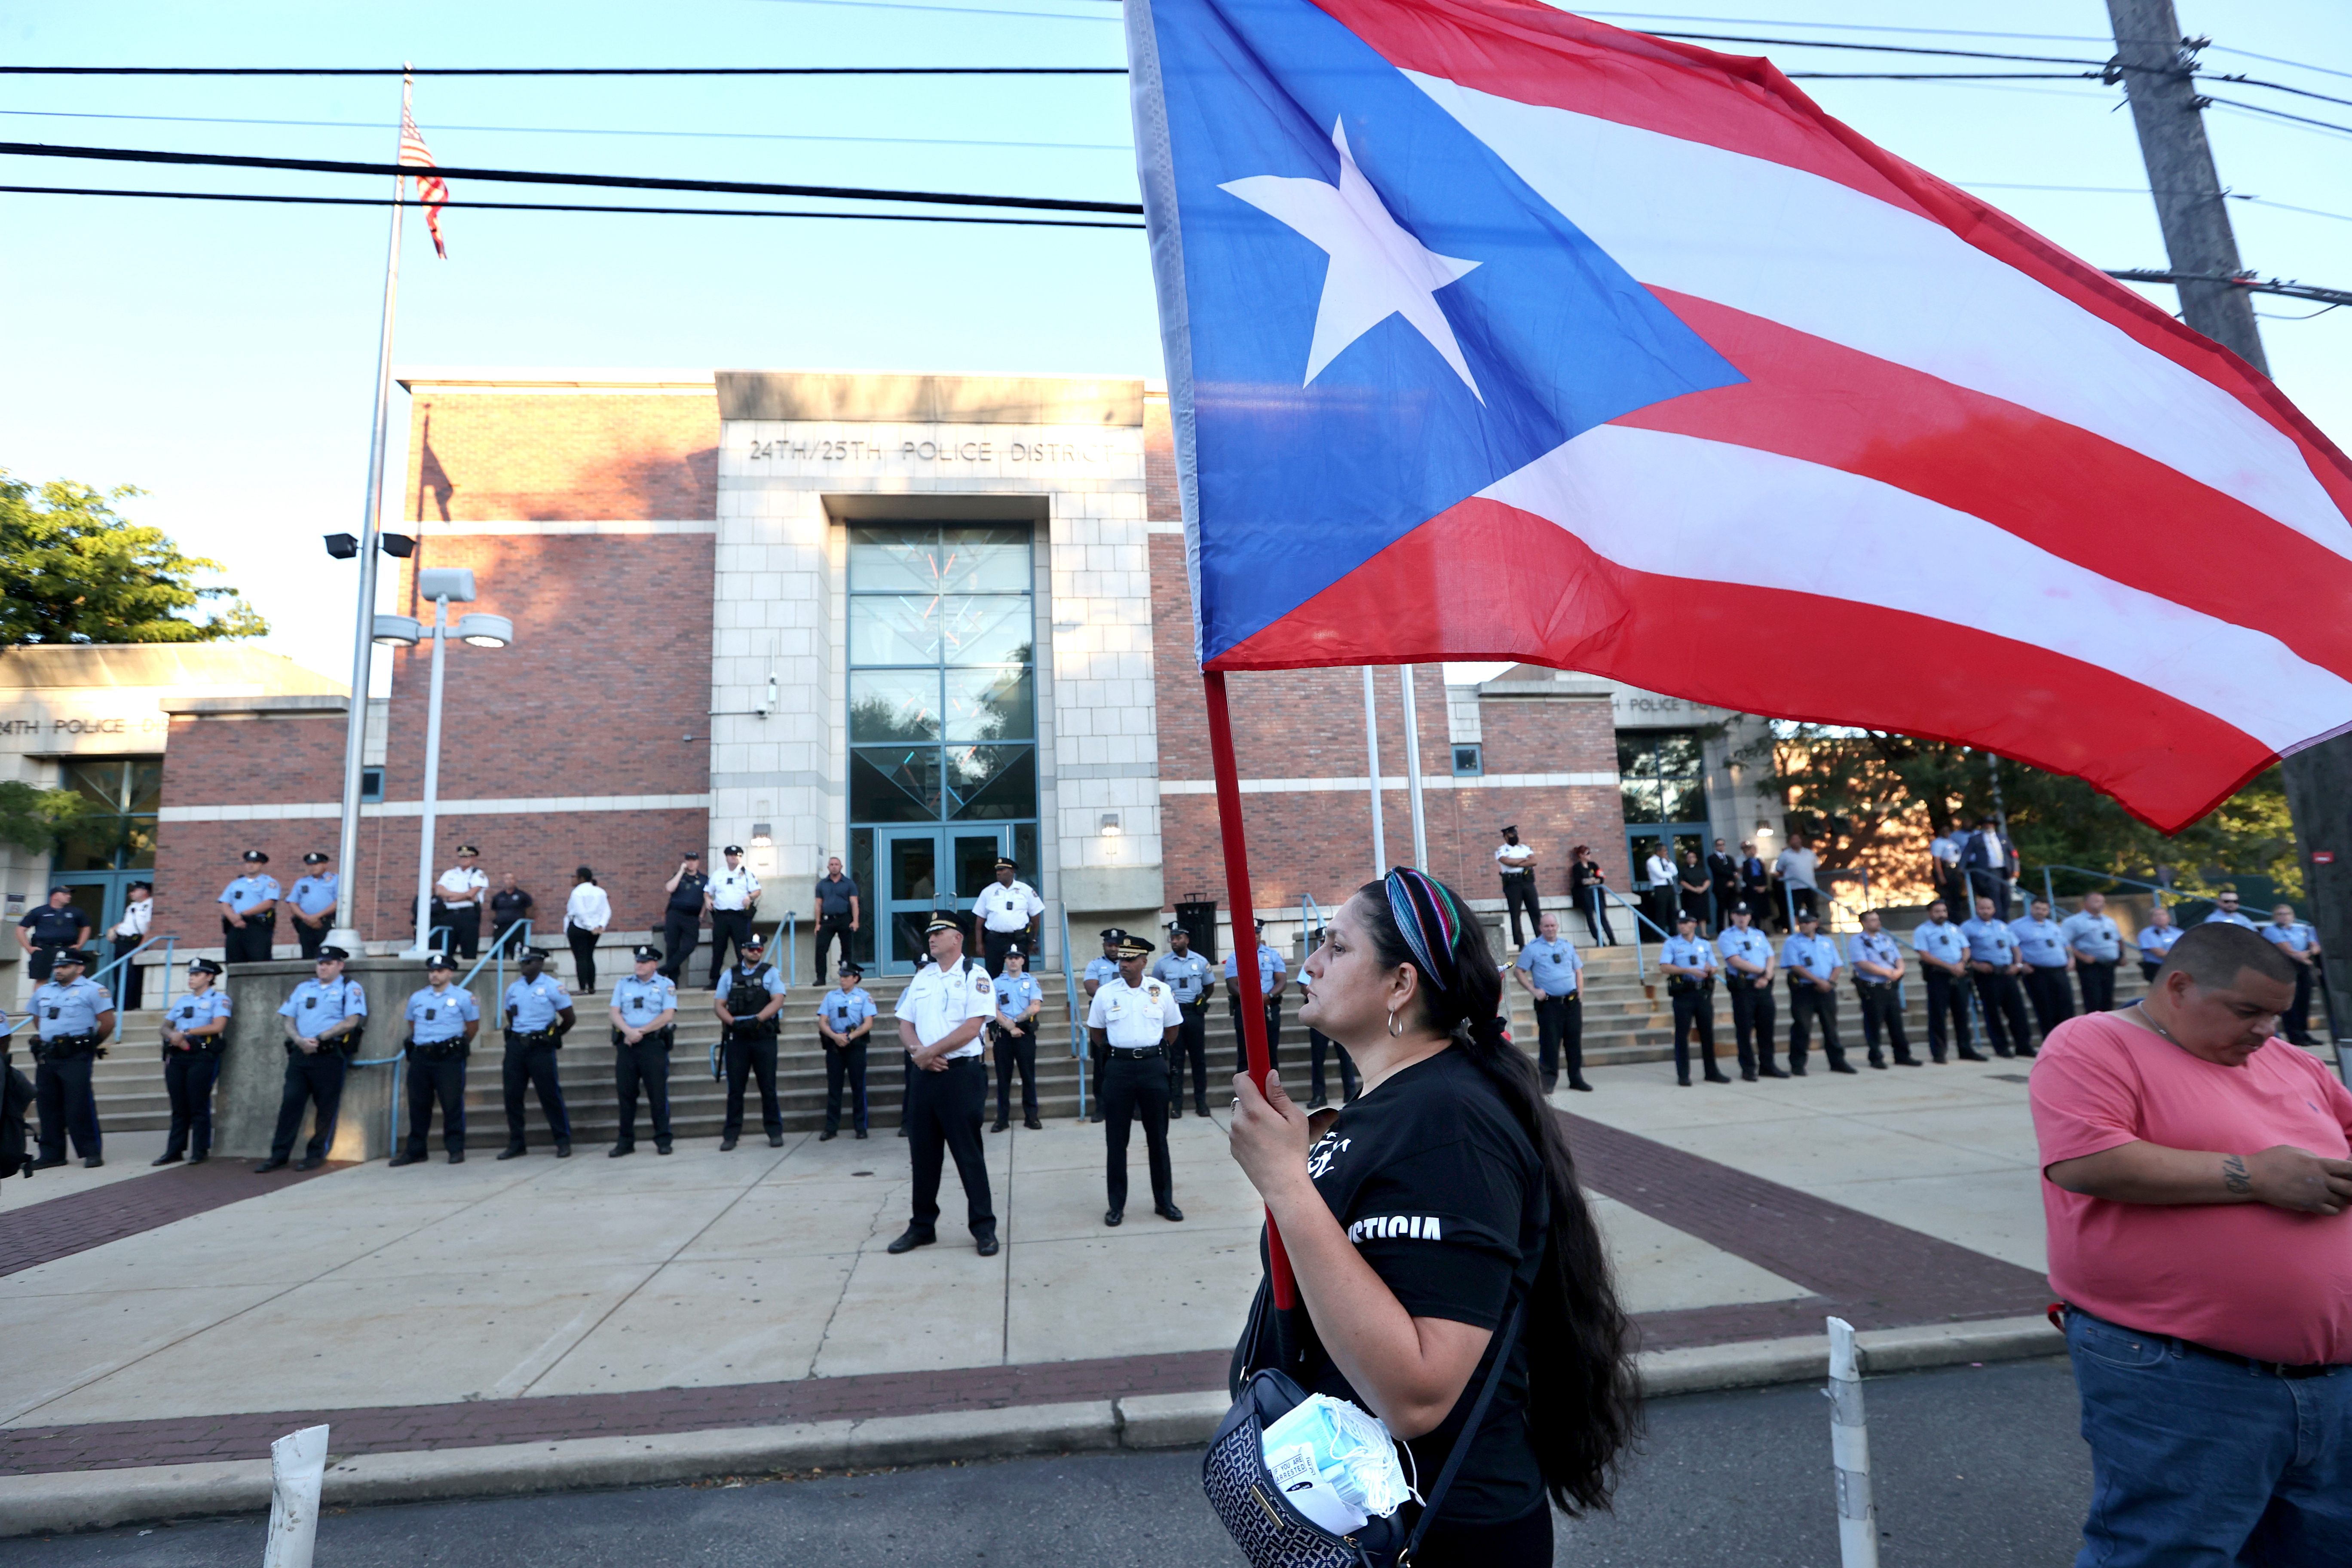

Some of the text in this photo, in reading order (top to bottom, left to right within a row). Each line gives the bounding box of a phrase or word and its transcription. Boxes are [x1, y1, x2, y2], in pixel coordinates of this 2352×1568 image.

[750, 439, 1114, 462] 24TH/25TH POLICE DISTRICT
[1630, 698, 1680, 711] POLICE
[54, 719, 126, 734] POLICE
[1280, 1462, 1290, 1471] YOU
[1293, 1456, 1303, 1466] ARE
[1276, 1464, 1305, 1482] ARRESTED
